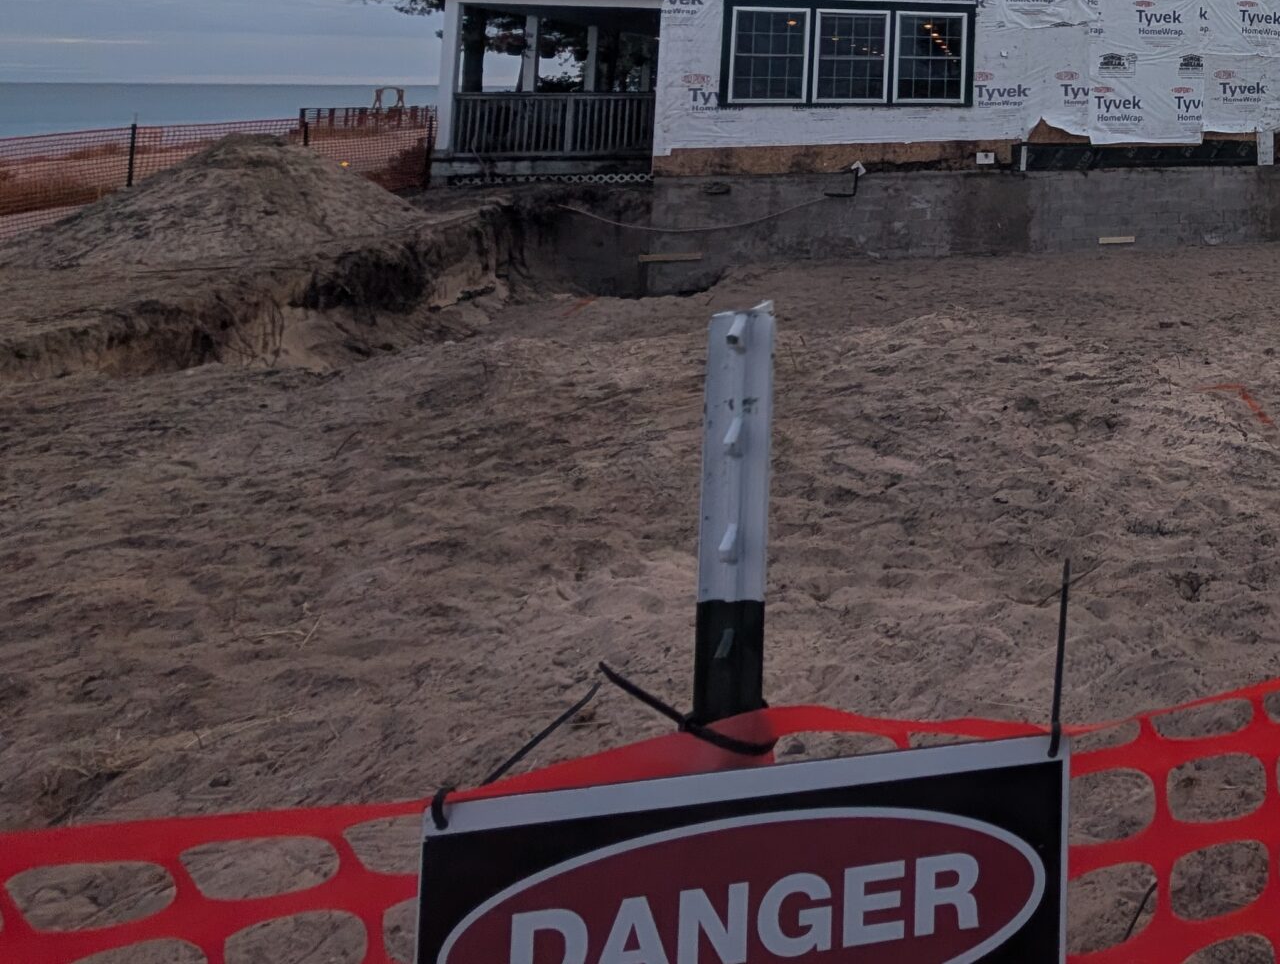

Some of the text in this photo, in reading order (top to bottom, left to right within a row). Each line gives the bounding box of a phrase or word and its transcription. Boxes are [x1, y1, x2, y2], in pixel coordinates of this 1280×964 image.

[1136, 10, 1182, 27] Tyvek
[975, 84, 1029, 101] Tyvek
[1061, 84, 1089, 99] Tyv
[1220, 82, 1267, 97] Tyvek
[1094, 96, 1142, 113] Tyvek
[1175, 96, 1203, 113] Tyv
[510, 853, 980, 964] DANGER
